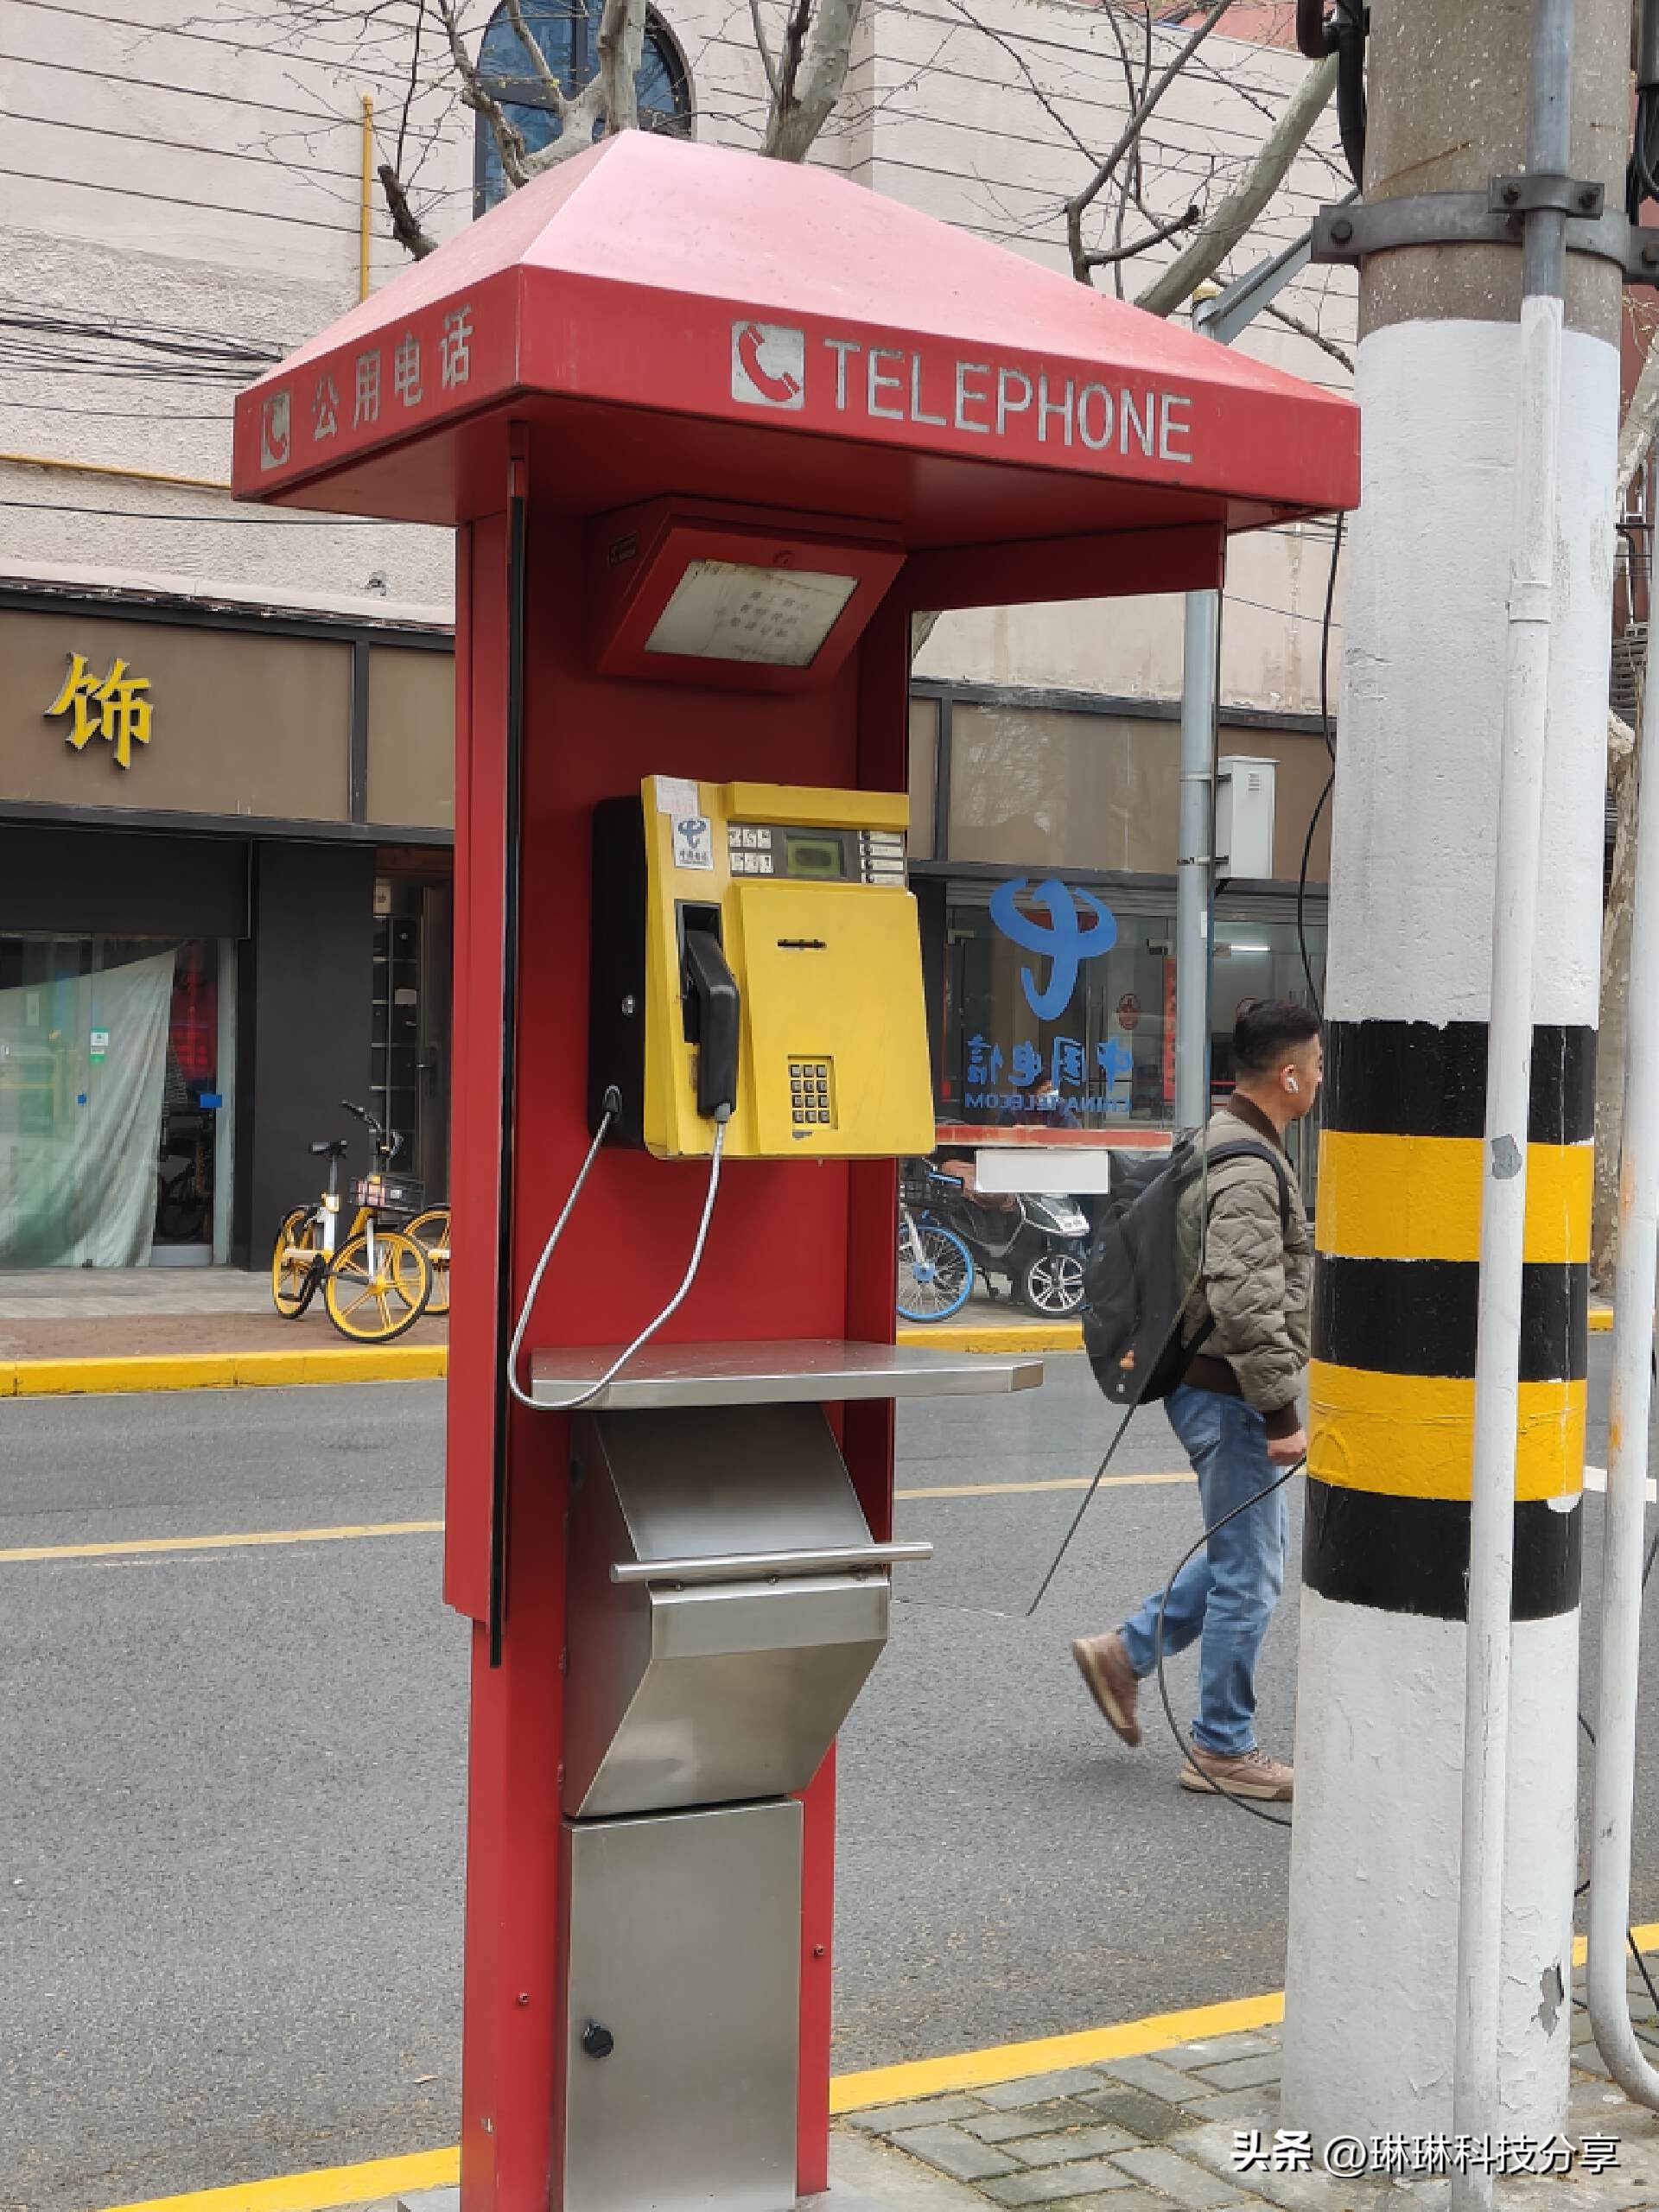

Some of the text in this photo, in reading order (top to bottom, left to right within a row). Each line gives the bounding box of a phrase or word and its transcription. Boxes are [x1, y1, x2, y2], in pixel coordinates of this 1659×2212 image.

[312, 303, 474, 442] 公用电话
[823, 338, 1192, 463] TELEPHONE
[44, 652, 155, 770] 饰
